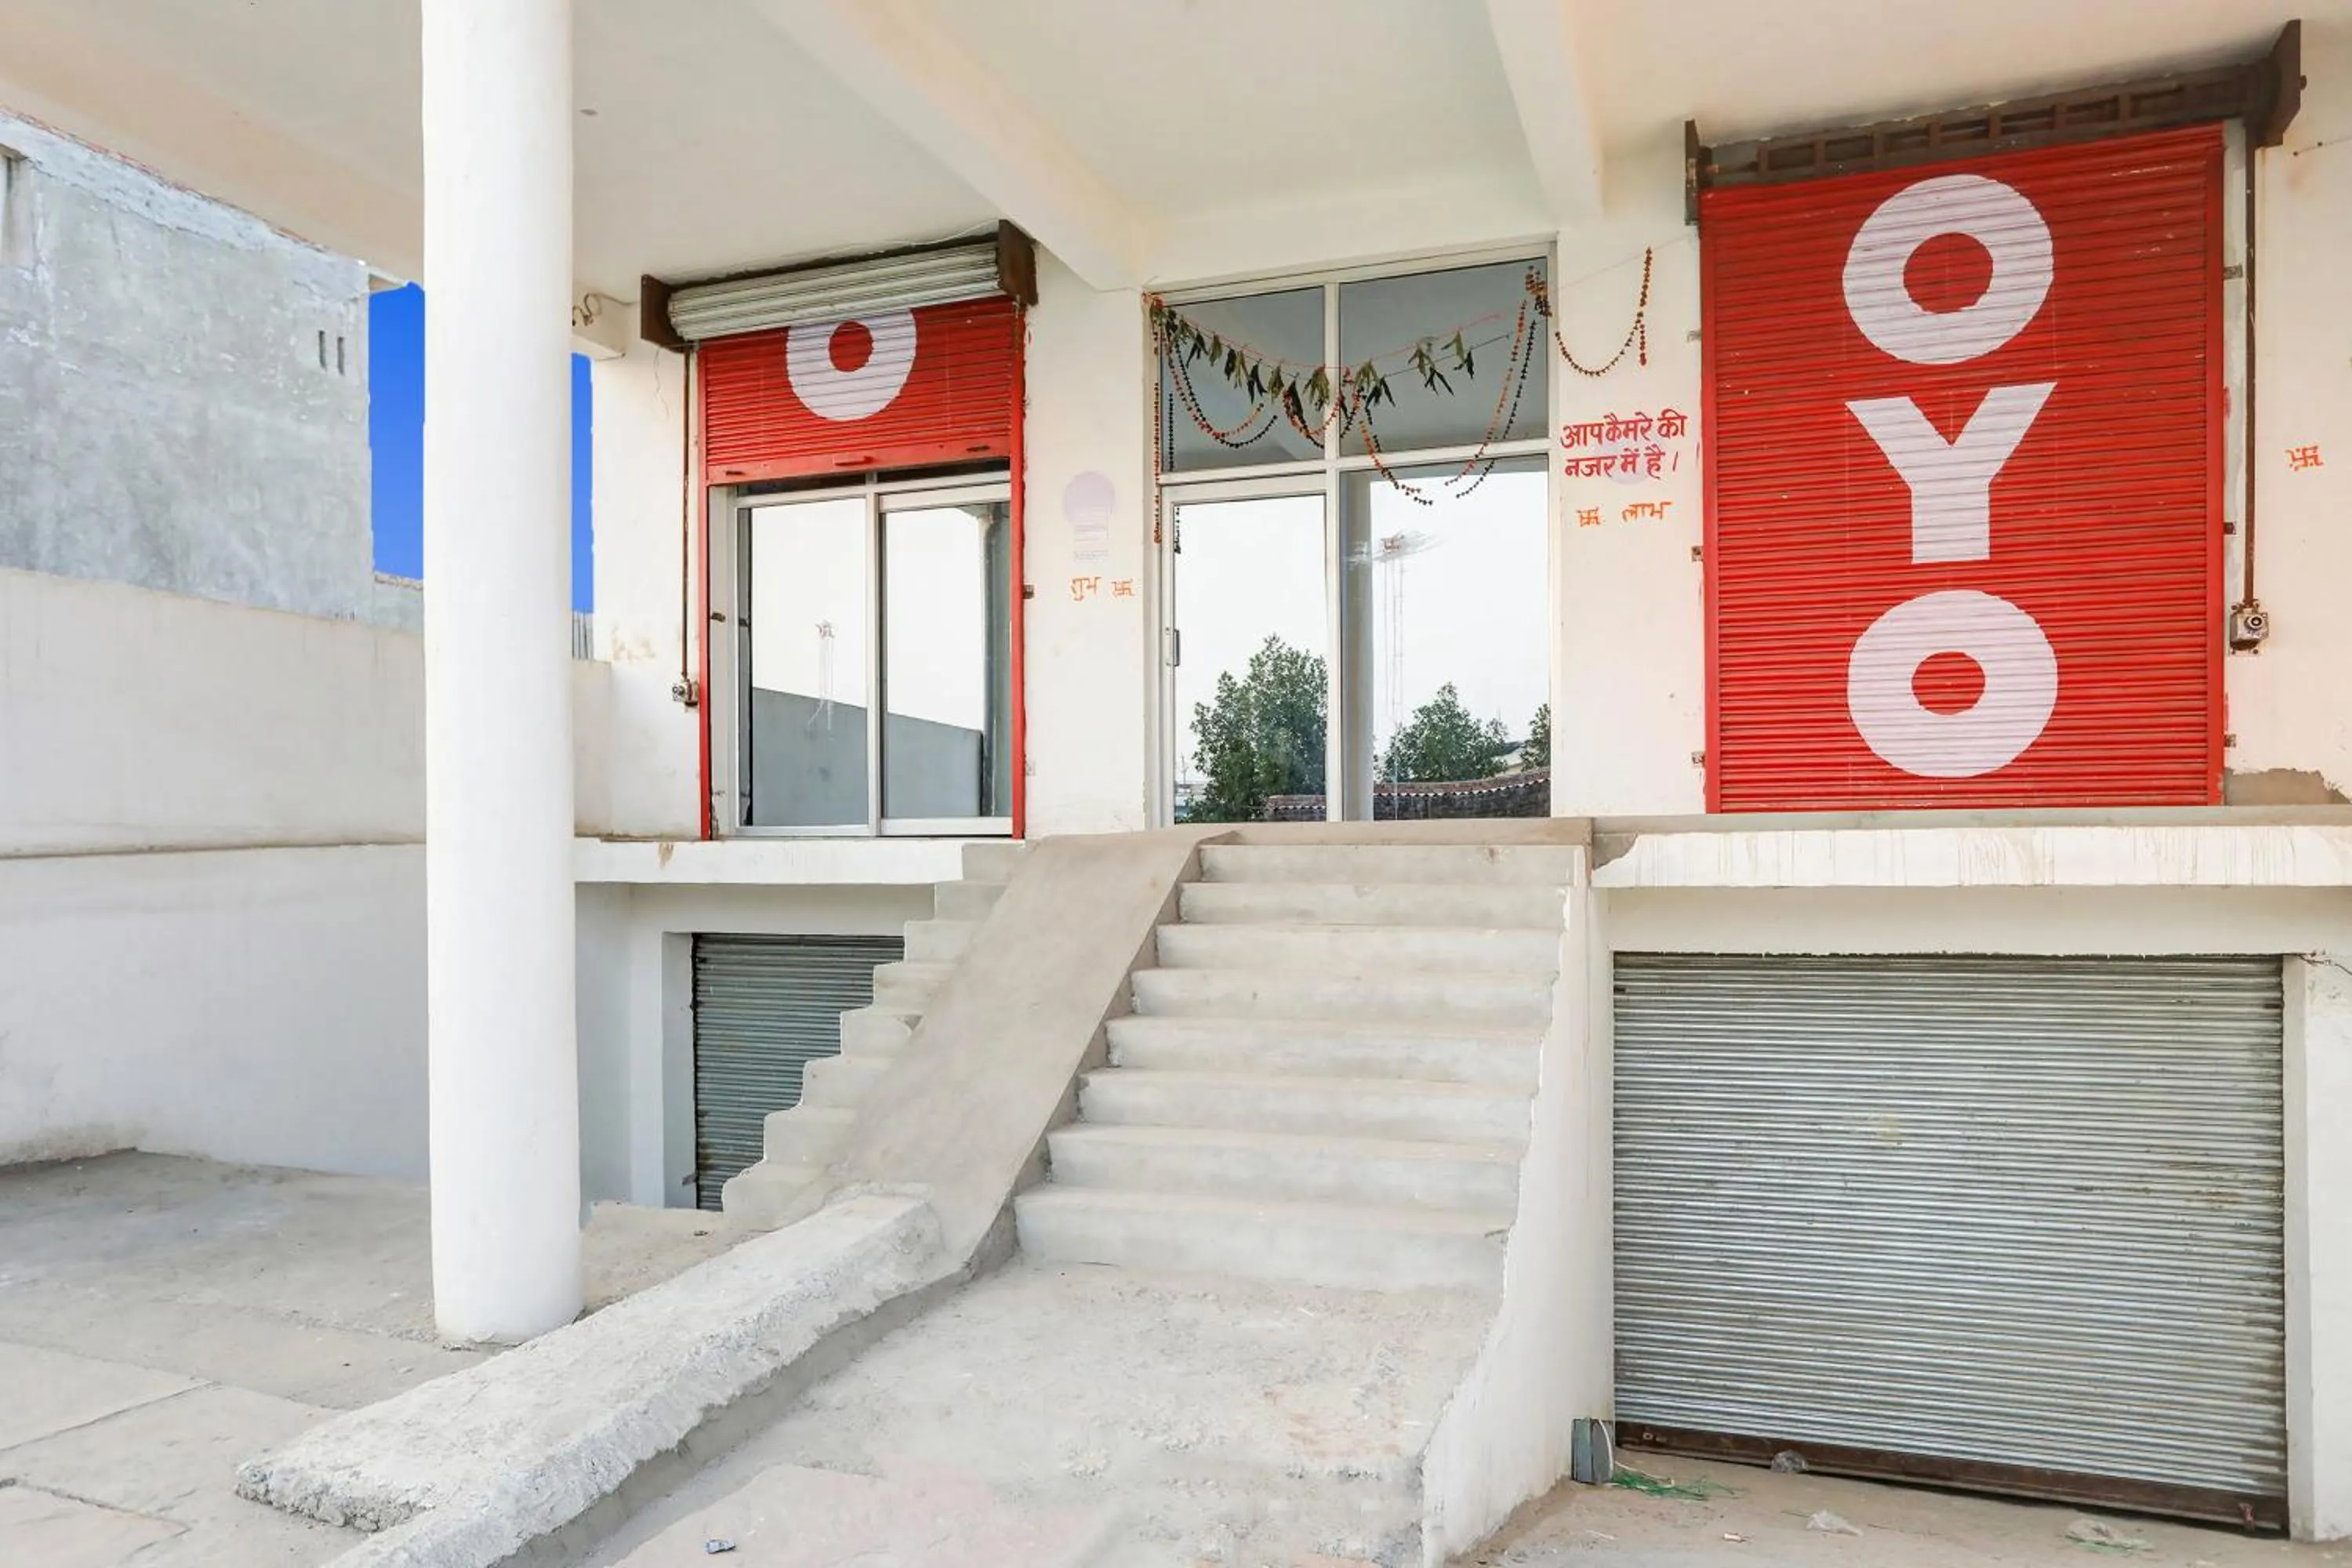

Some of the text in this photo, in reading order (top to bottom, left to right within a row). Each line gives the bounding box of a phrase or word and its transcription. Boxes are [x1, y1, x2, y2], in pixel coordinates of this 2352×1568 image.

[1657, 408, 1688, 439] की
[1565, 455, 1617, 477] नजर
[1620, 448, 1640, 474] में
[1842, 173, 2058, 779] OYO
[1622, 502, 1672, 521] लाभ
[1070, 576, 1102, 601] शुभ
